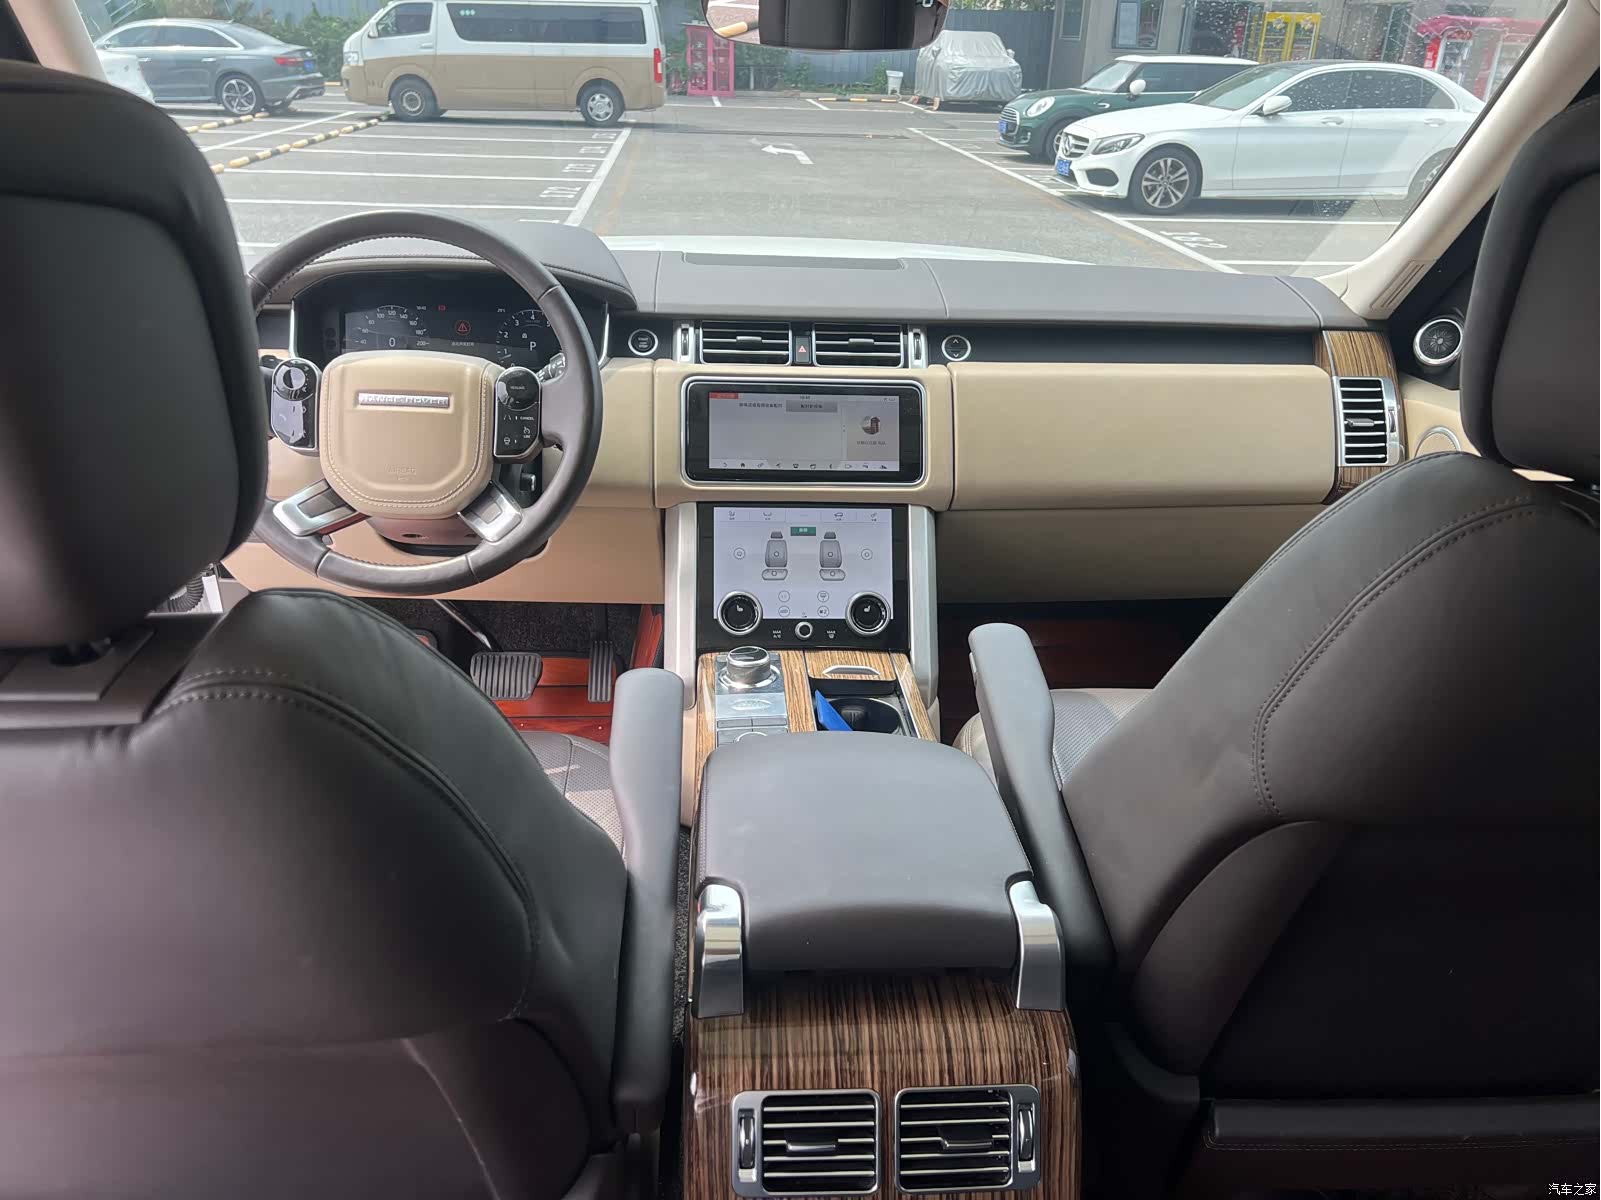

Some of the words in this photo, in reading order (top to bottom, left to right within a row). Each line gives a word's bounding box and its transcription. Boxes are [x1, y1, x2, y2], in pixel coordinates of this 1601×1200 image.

[539, 186, 582, 198] 172
[1159, 230, 1228, 249] 162
[388, 337, 396, 348] 0
[529, 341, 537, 351] P
